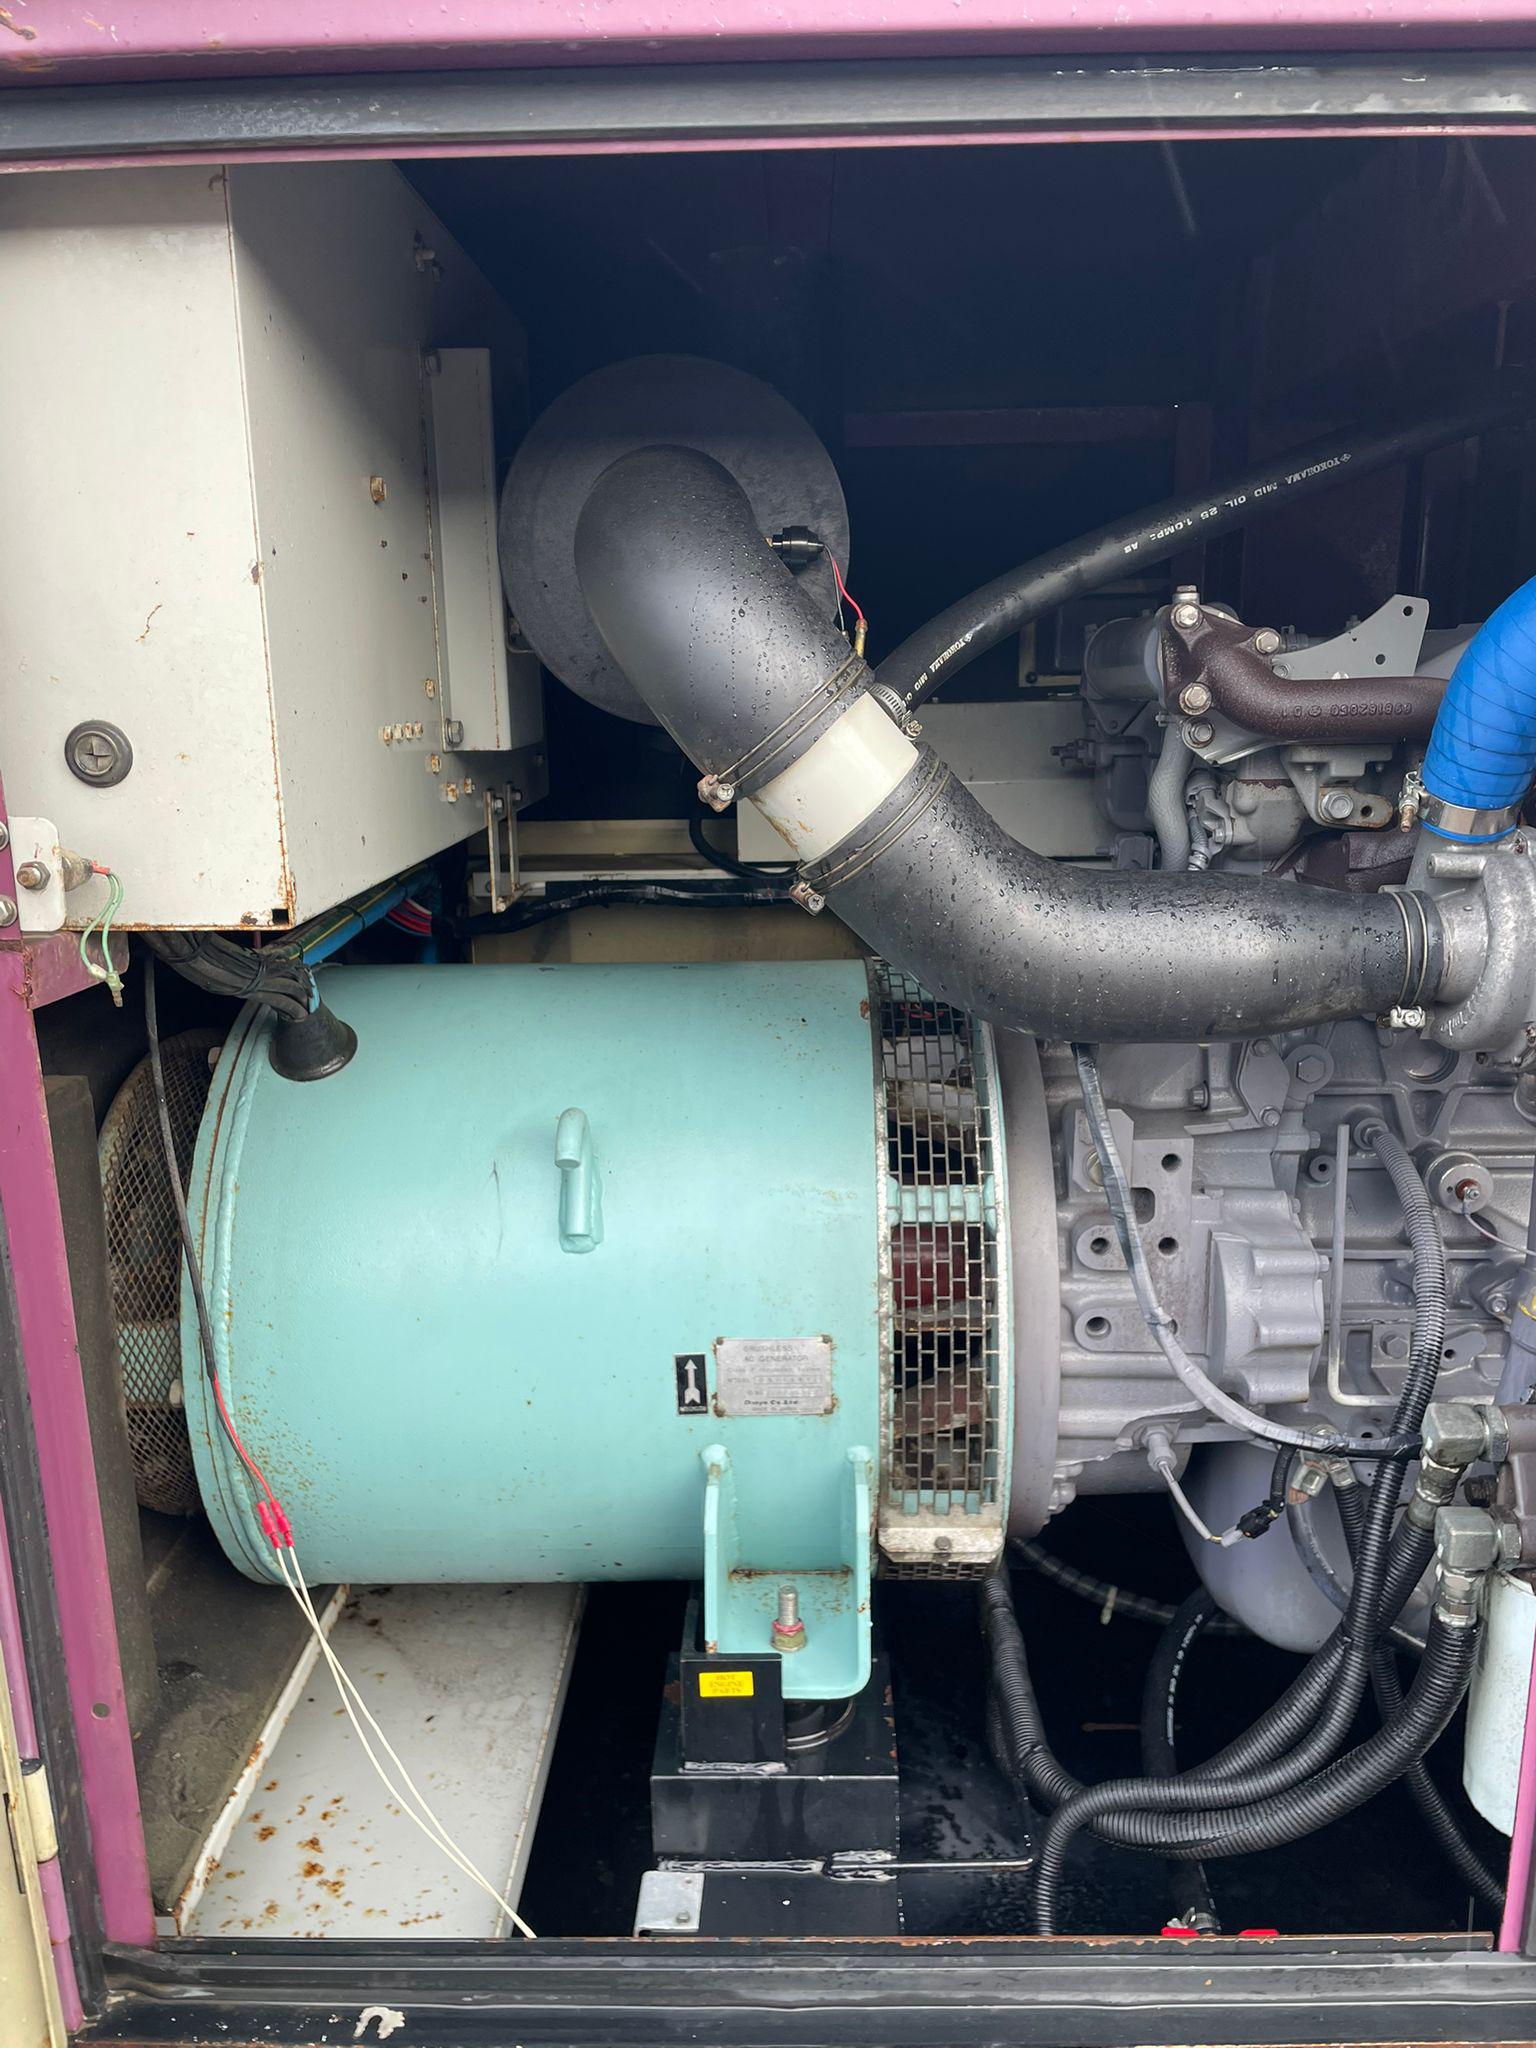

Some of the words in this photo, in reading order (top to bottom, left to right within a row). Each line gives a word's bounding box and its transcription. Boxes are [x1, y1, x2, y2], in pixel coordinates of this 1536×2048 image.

[1284, 457, 1341, 484] YOKOHAMA
[1253, 482, 1278, 497] MID
[1225, 495, 1247, 508] OIL
[1200, 506, 1218, 520] 25
[929, 638, 966, 673] YOKOHAMA
[914, 672, 928, 691] MID
